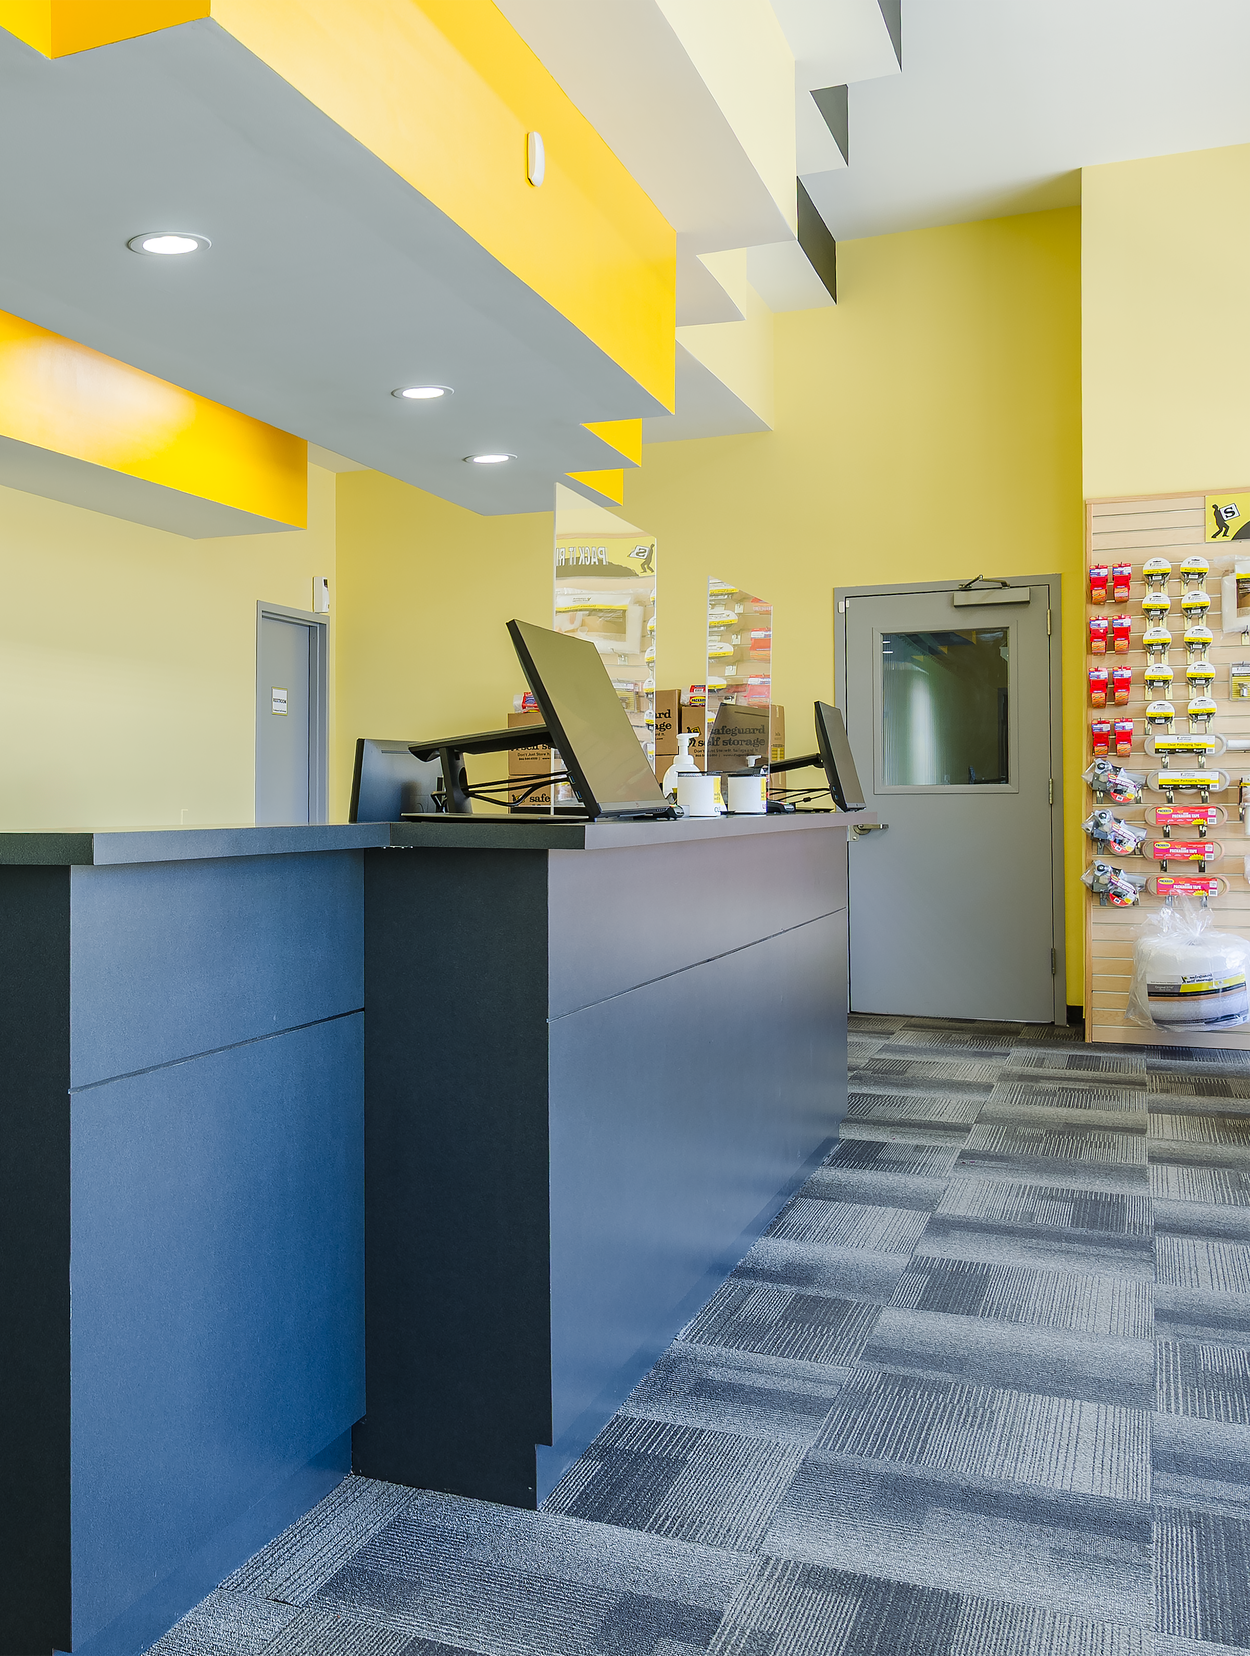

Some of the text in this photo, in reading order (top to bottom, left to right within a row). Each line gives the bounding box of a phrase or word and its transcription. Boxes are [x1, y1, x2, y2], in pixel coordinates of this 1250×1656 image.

[1224, 506, 1236, 518] S
[722, 738, 766, 747] storage
[529, 793, 550, 802] safe
